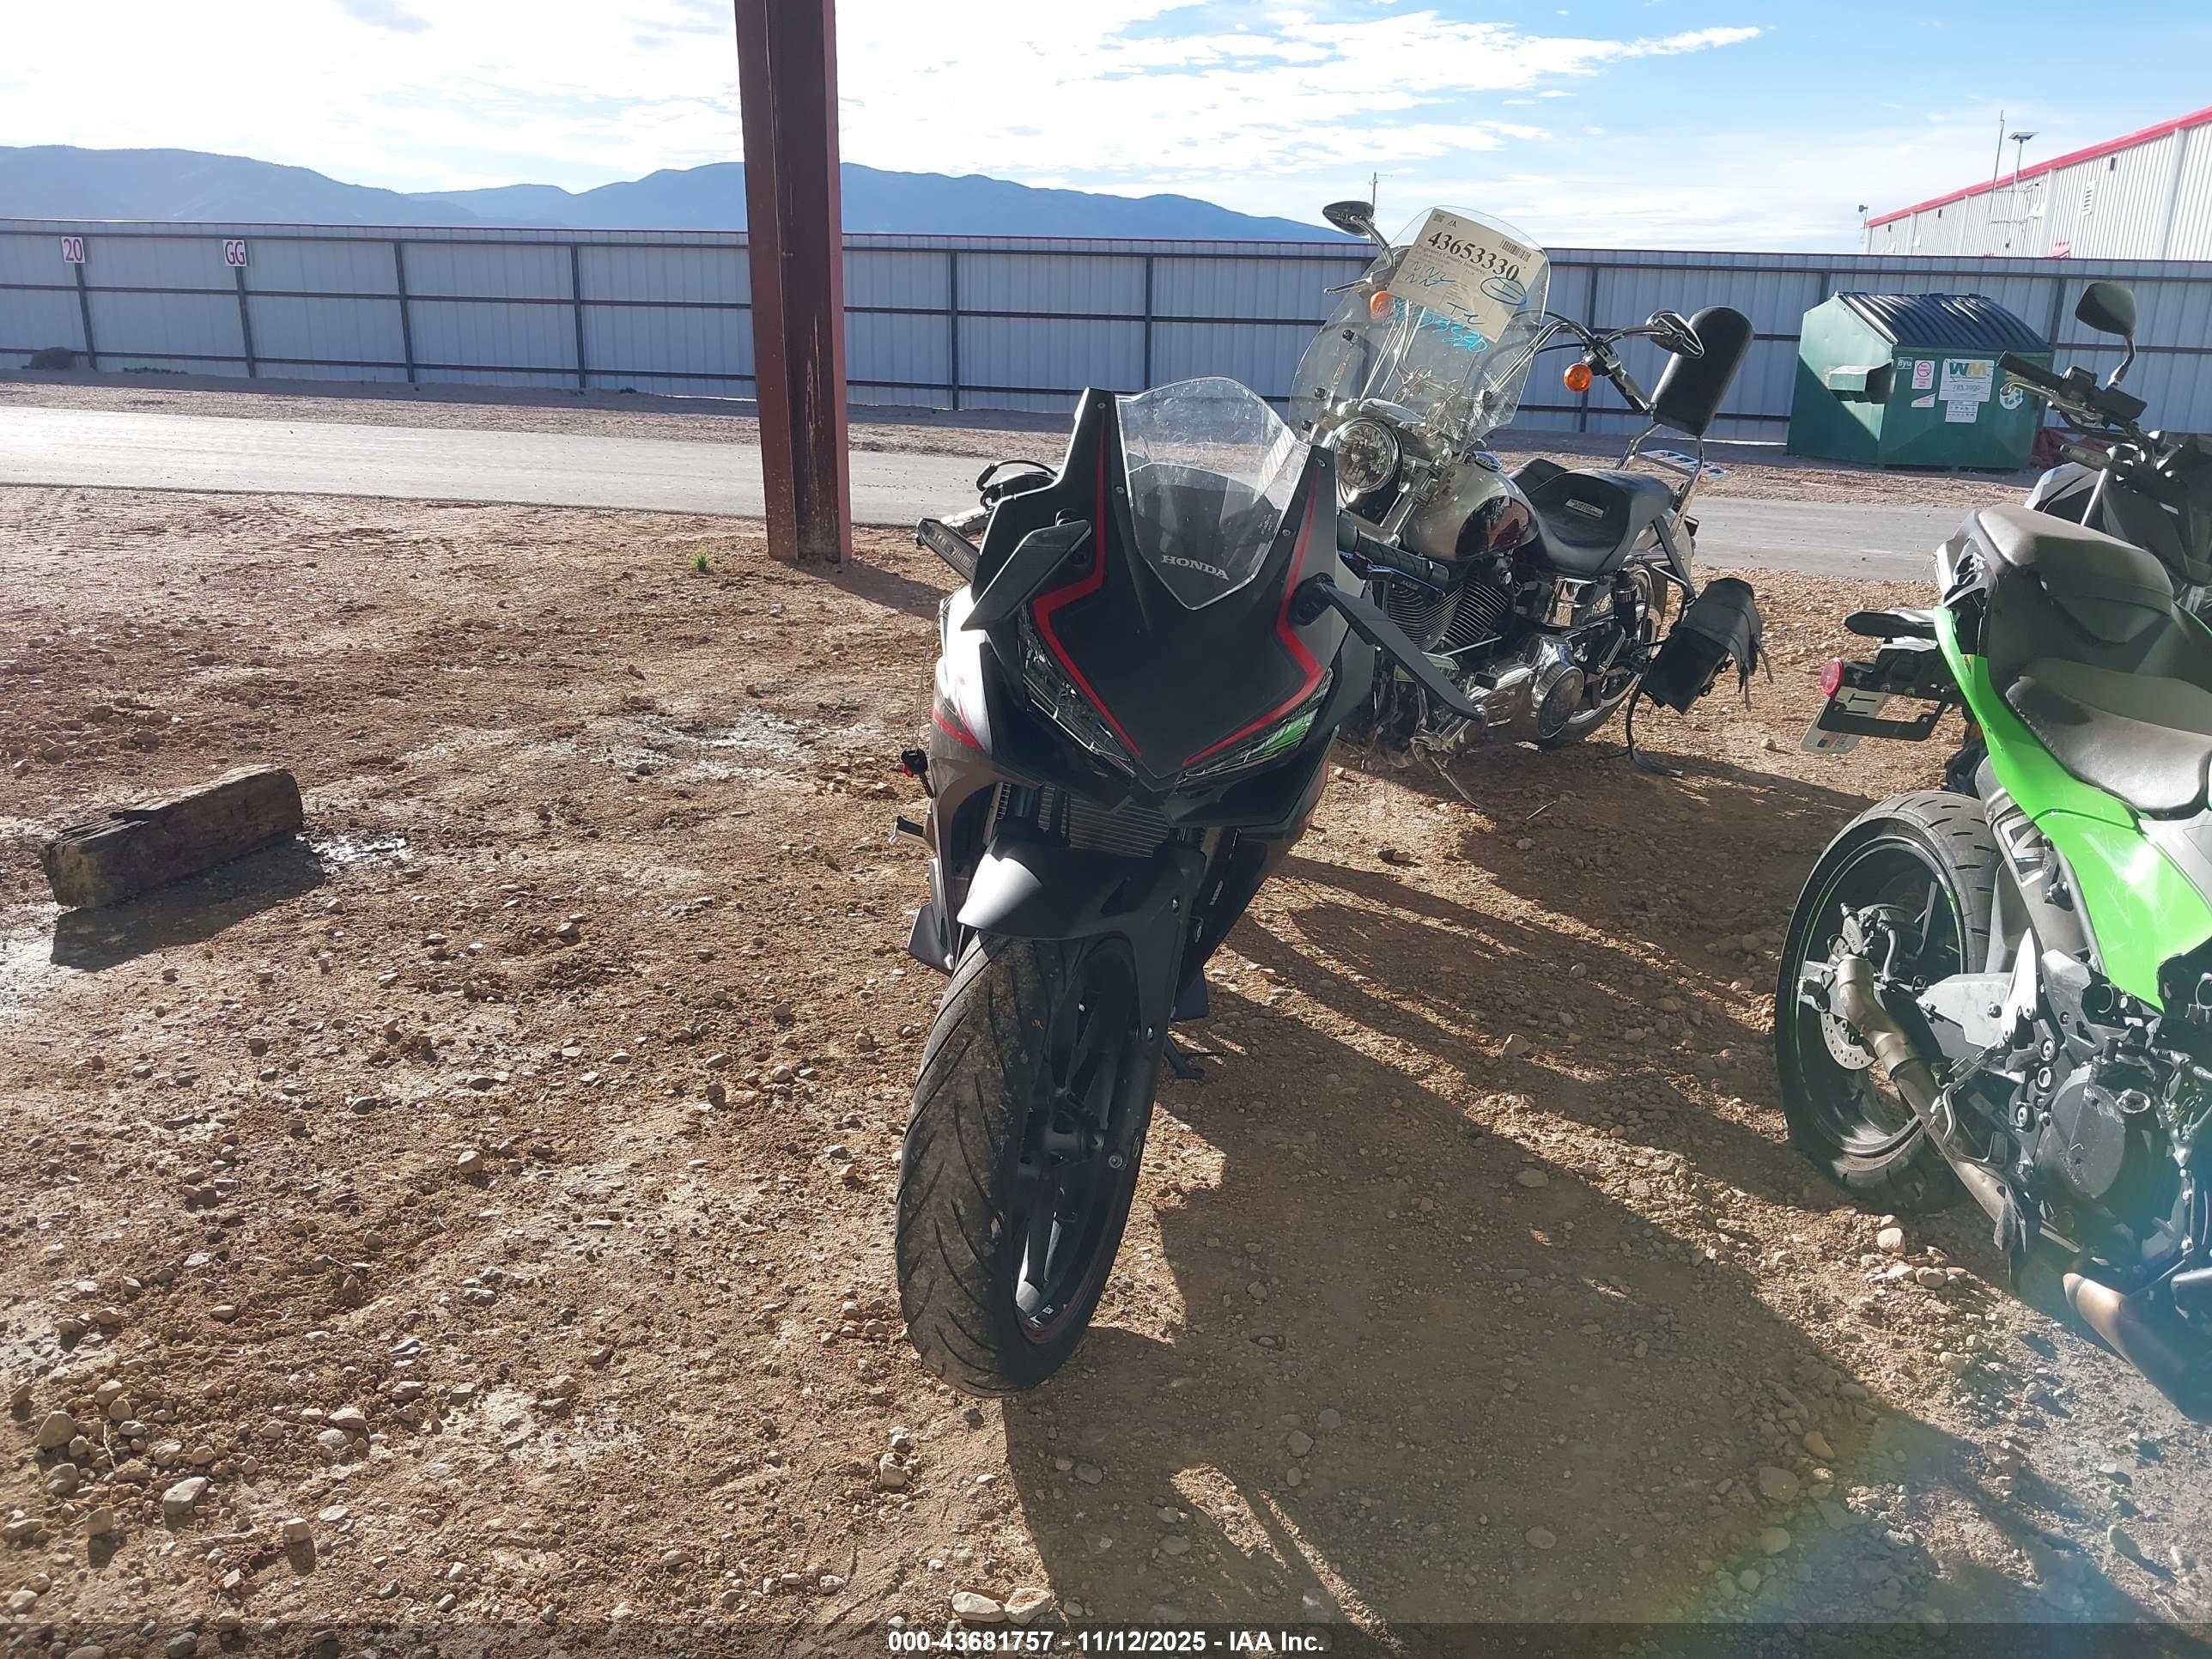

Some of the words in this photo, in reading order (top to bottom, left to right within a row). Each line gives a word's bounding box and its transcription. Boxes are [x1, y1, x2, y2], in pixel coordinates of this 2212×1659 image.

[64, 238, 83, 262] 20
[225, 240, 246, 265] GG
[1428, 230, 1520, 282] 43653330
[1949, 362, 1986, 378] WM
[1160, 555, 1231, 581] HONDA
